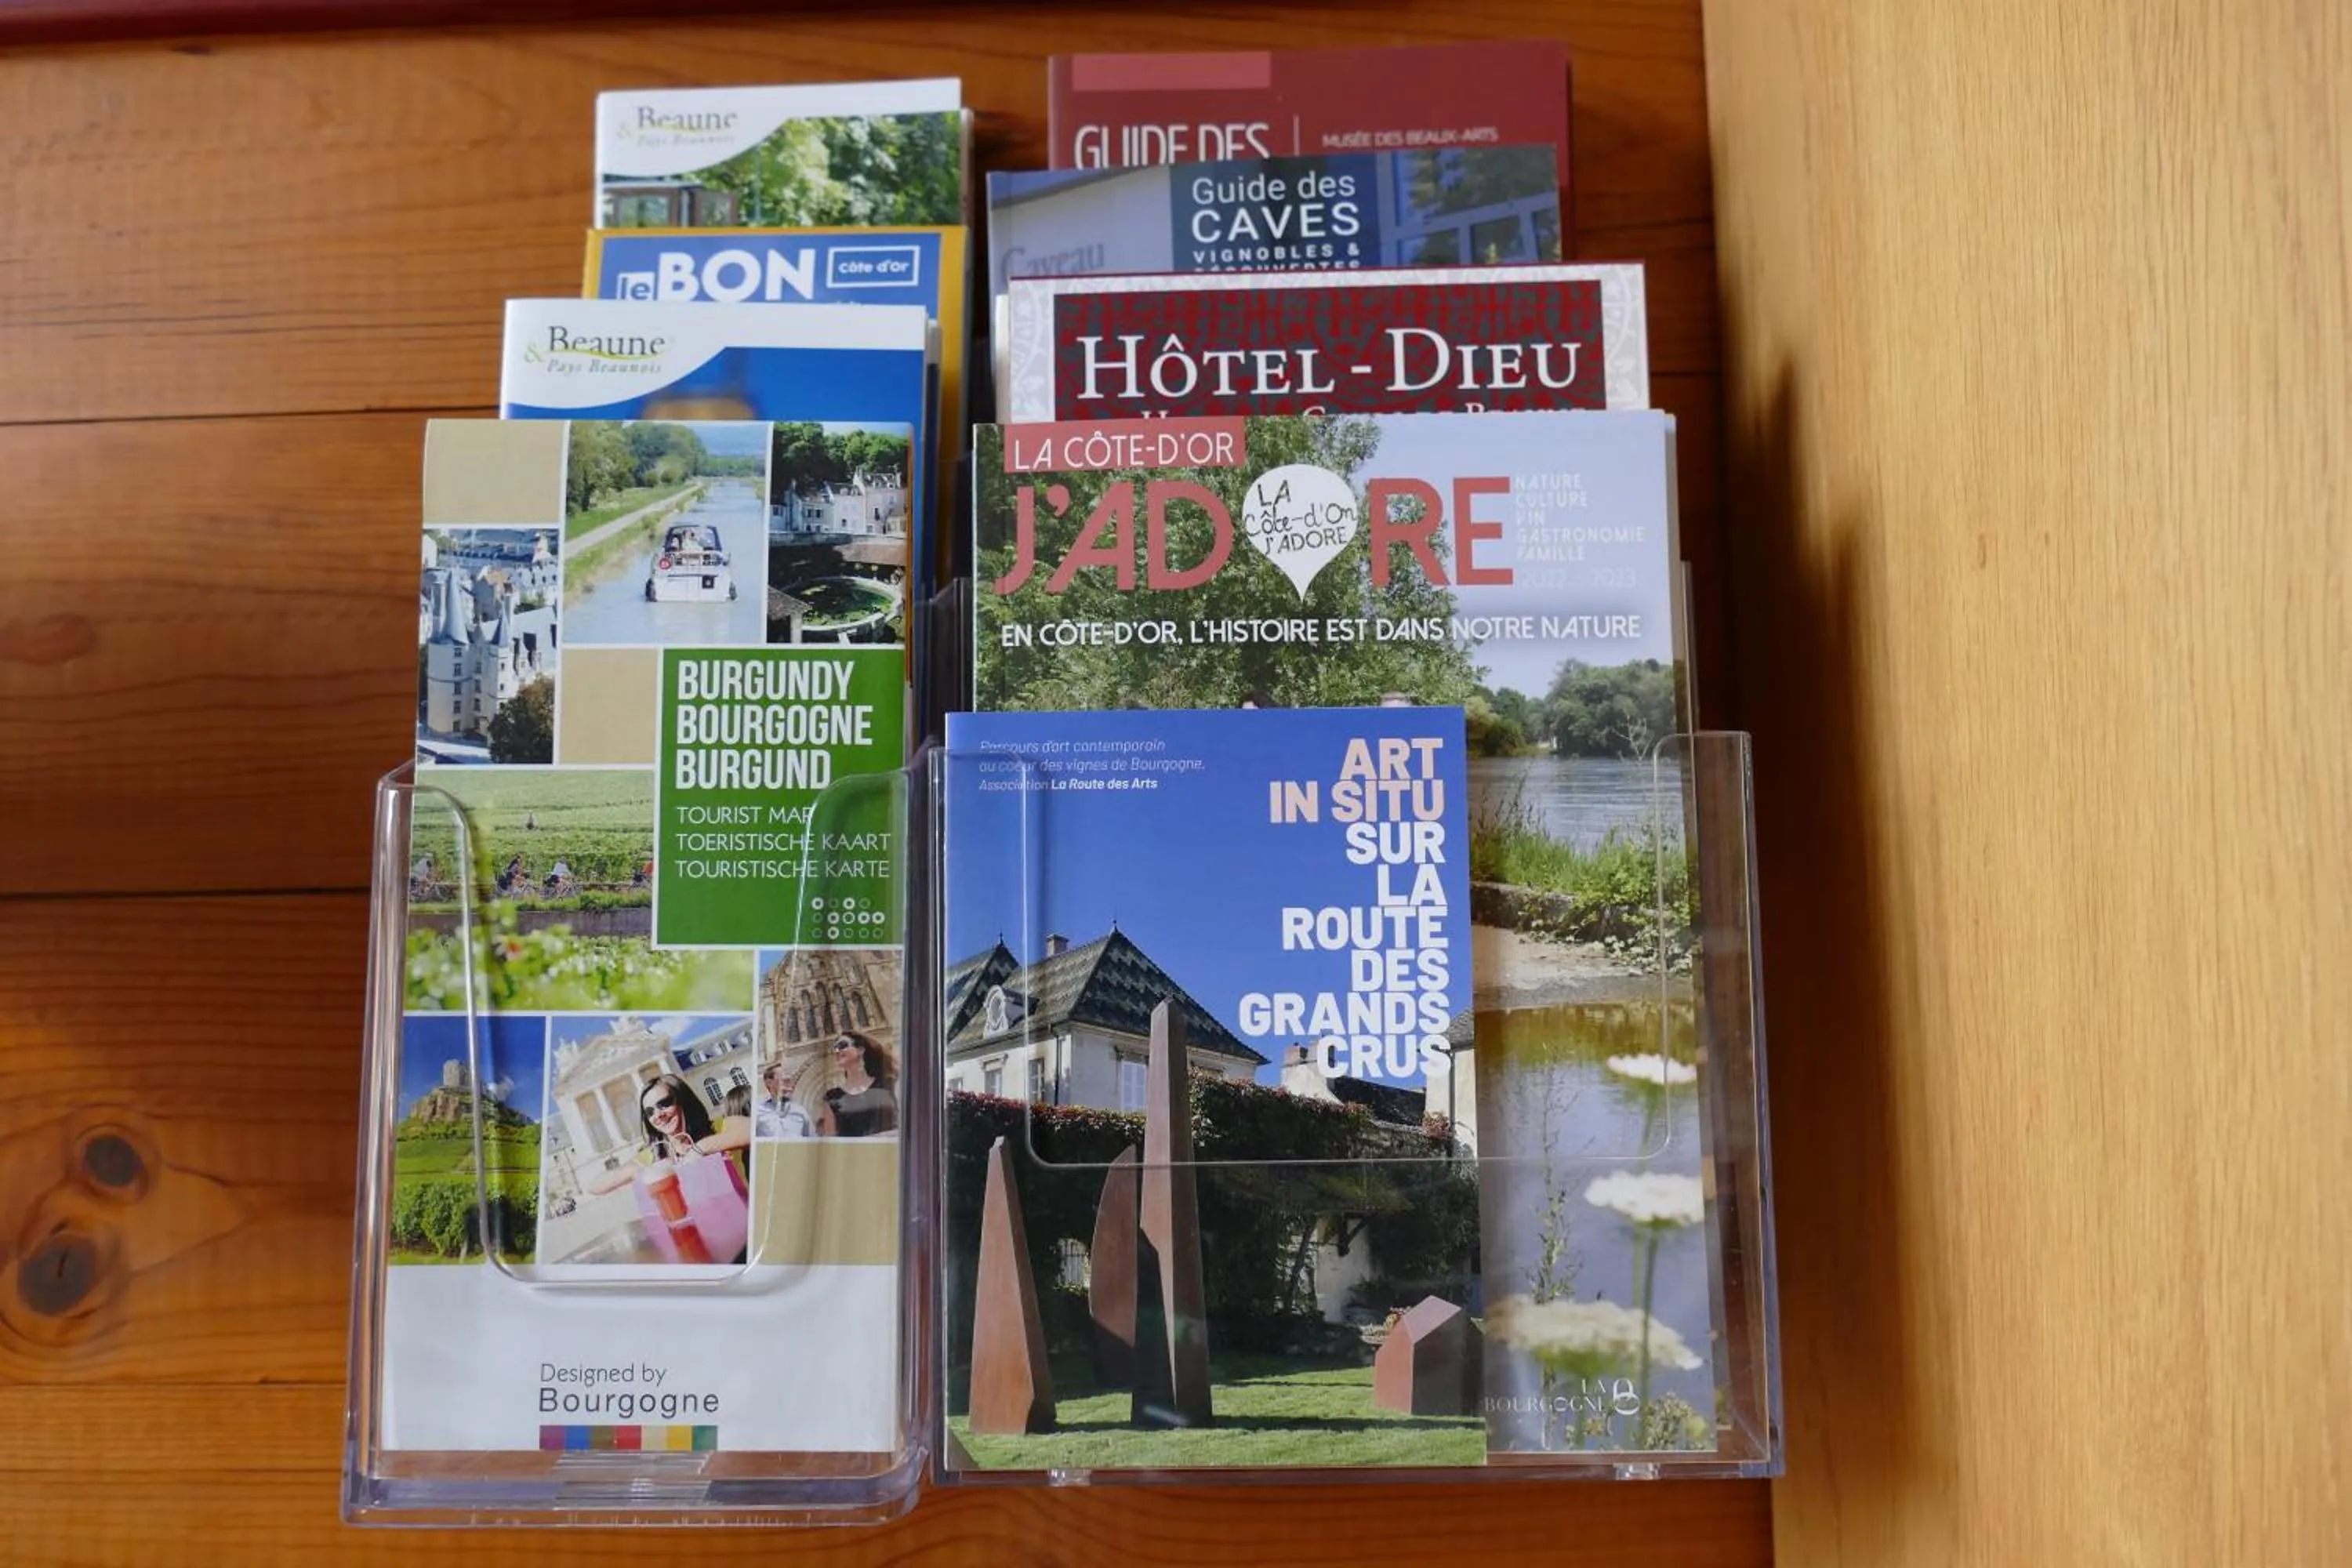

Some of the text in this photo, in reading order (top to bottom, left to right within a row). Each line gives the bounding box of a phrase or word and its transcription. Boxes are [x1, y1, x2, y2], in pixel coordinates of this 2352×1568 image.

[637, 104, 738, 131] Beaune
[1073, 122, 1270, 170] GUIDE DES
[1374, 129, 1404, 147] DES
[1192, 169, 1356, 205] Guide des
[1191, 201, 1361, 244] CAVES
[838, 258, 910, 274] côte d'or
[1192, 241, 1361, 264] VIGNOBLES &
[656, 248, 816, 303] BON
[548, 325, 666, 356] Beaune
[1014, 430, 1235, 470] LA CÔTE-D'OR
[1257, 479, 1291, 506] LA
[1515, 473, 1581, 490] NATURE
[1515, 491, 1588, 508] CULTURE
[1515, 510, 1545, 527] VIN
[1264, 526, 1348, 556] J'ADORE
[1517, 526, 1645, 543] GASTRONOMIE
[1517, 545, 1585, 561] FAMILLE
[1000, 615, 1642, 647] EN CÔTE-D'OR, L'HISTOIRE EST DANS NOTRE NATURE
[677, 659, 855, 701] BURGUNDY
[676, 704, 873, 746] BOURGOGNE
[675, 748, 832, 790] BURGUND
[1040, 759, 1062, 771] des
[1066, 758, 1108, 774] vignes
[1111, 757, 1128, 771] de
[1340, 738, 1443, 779] ART
[1051, 779, 1066, 789] La
[1069, 778, 1105, 790] Route
[1107, 777, 1129, 789] des
[1131, 777, 1159, 789] Arts
[676, 806, 762, 825] TOURIST
[1269, 779, 1445, 823] IN SITU
[675, 833, 891, 851] TOERISTISCHE KAART
[1345, 822, 1445, 864] SUR
[675, 859, 890, 879] TOURISTISCHE KARTE
[1377, 864, 1446, 906] LA
[1282, 906, 1448, 950] ROUTE
[1351, 949, 1450, 992] DES
[1239, 992, 1450, 1036] GRANDS
[1316, 1034, 1451, 1079] CRUS
[540, 1363, 667, 1387] Designed by
[1581, 1378, 1606, 1394] LA
[539, 1387, 720, 1419] Bourgogne
